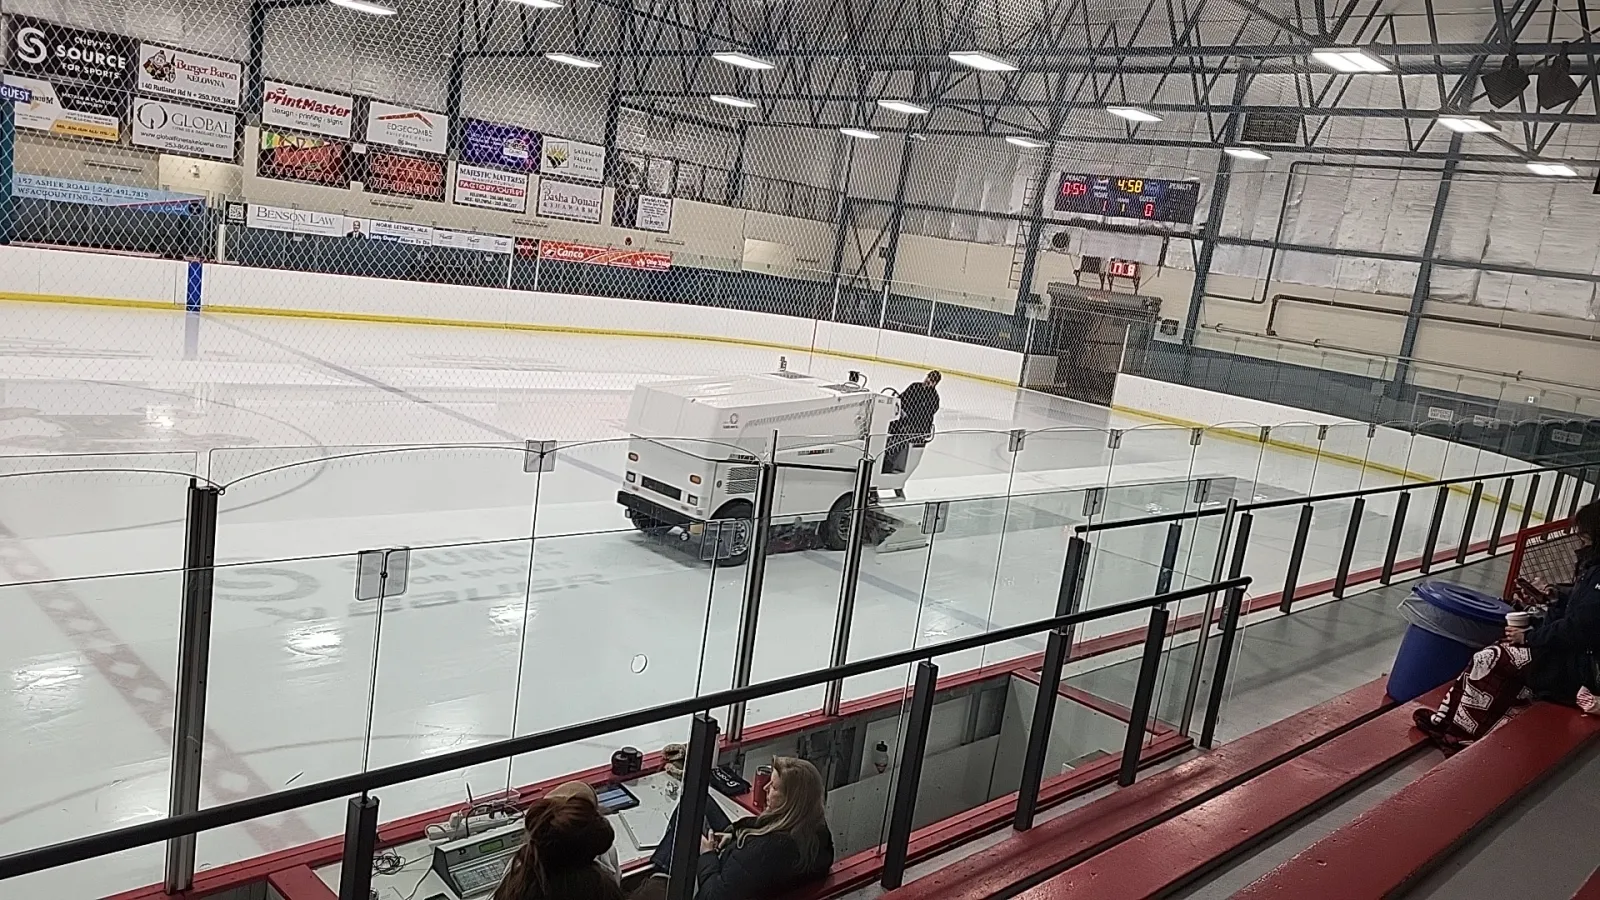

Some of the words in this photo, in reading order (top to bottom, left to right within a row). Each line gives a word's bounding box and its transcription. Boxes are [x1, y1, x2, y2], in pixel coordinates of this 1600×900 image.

[55, 45, 127, 70] SOURCE
[62, 61, 81, 73] FOR
[84, 66, 120, 80] SPORTS
[176, 58, 208, 76] Burger
[210, 66, 238, 81] Baron
[187, 74, 225, 88] KELOWNA
[1, 86, 30, 102] GUEST
[153, 85, 176, 95] Rutland
[172, 112, 233, 134] GLOBAL
[574, 148, 602, 158] OKANAGAN
[460, 167, 492, 179] MAJESTIC
[493, 173, 525, 184] MATTRESS
[35, 179, 64, 188] ASHER
[66, 182, 90, 191] ROAD
[460, 181, 495, 192] FACTORY
[1062, 181, 1087, 195] 0:54
[1118, 179, 1143, 193] 4:58
[1169, 183, 1193, 191] PENALTY
[17, 188, 103, 203] WSACCOUNTING.CA
[543, 190, 568, 204] Basha
[571, 195, 600, 208] Donair
[1144, 203, 1153, 217] 0
[557, 248, 584, 259] Canco
